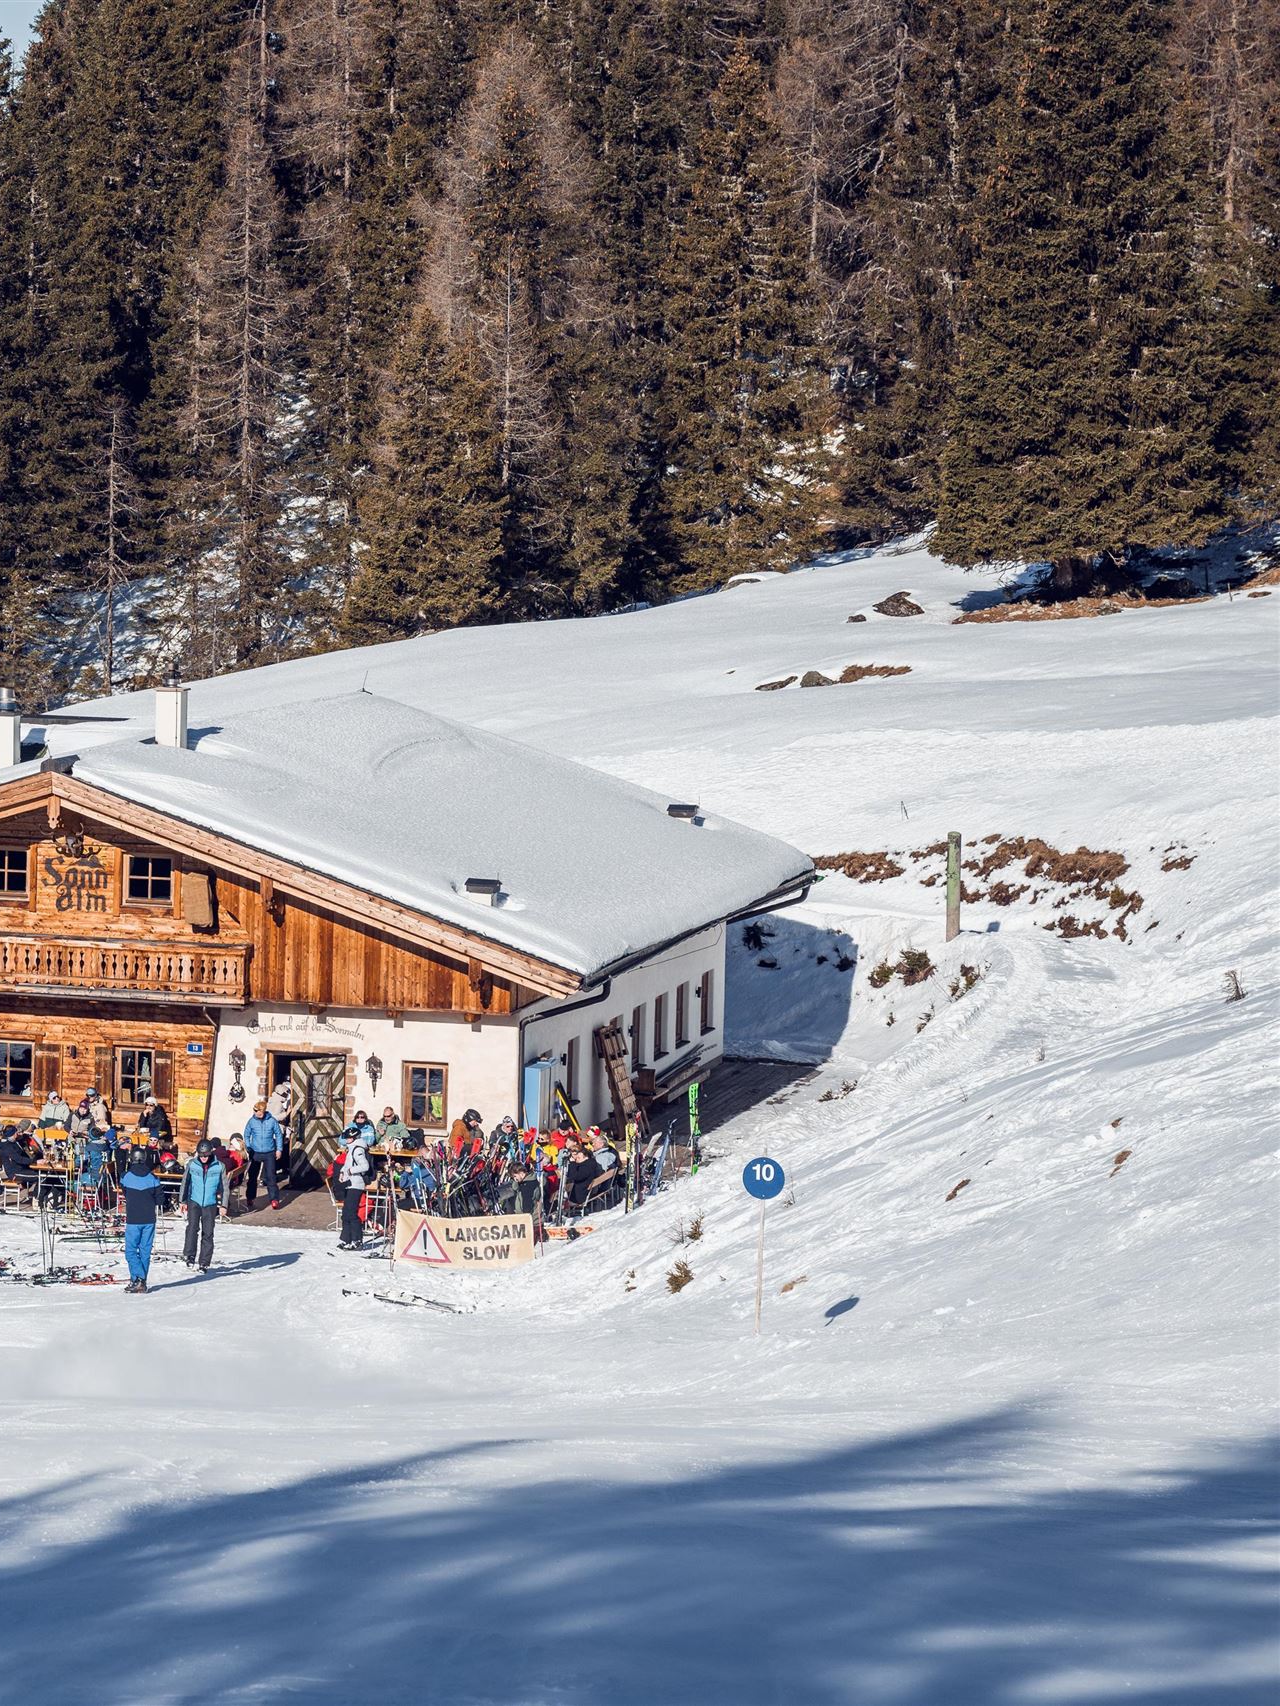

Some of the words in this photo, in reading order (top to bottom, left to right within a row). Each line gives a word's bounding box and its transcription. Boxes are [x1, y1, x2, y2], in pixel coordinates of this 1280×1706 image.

[41, 856, 108, 889] Sonn
[325, 1018, 365, 1041] Sonnalm
[752, 1163, 775, 1182] 10
[445, 1224, 526, 1242] LANGSAM
[463, 1244, 510, 1260] SLOW
